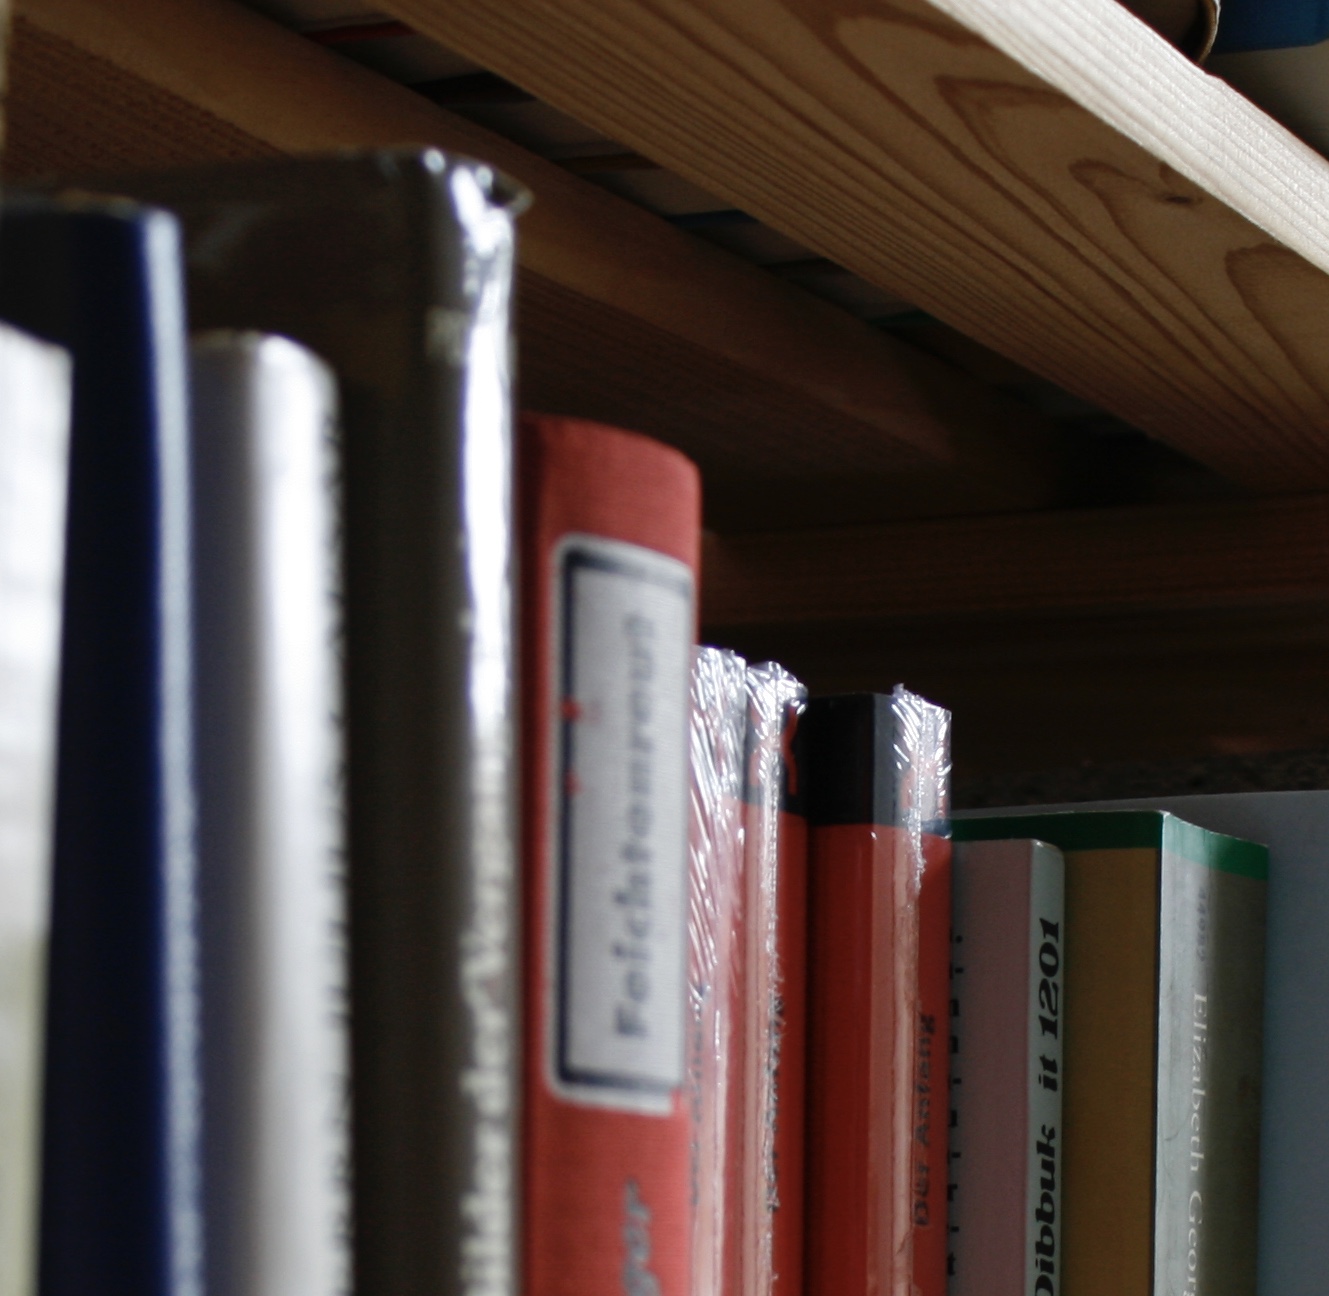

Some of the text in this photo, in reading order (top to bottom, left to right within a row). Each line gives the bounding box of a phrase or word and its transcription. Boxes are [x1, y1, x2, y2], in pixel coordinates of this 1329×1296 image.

[1038, 917, 1060, 1041] 1201
[1038, 1055, 1058, 1094] it
[1188, 992, 1207, 1172] Elizabeth
